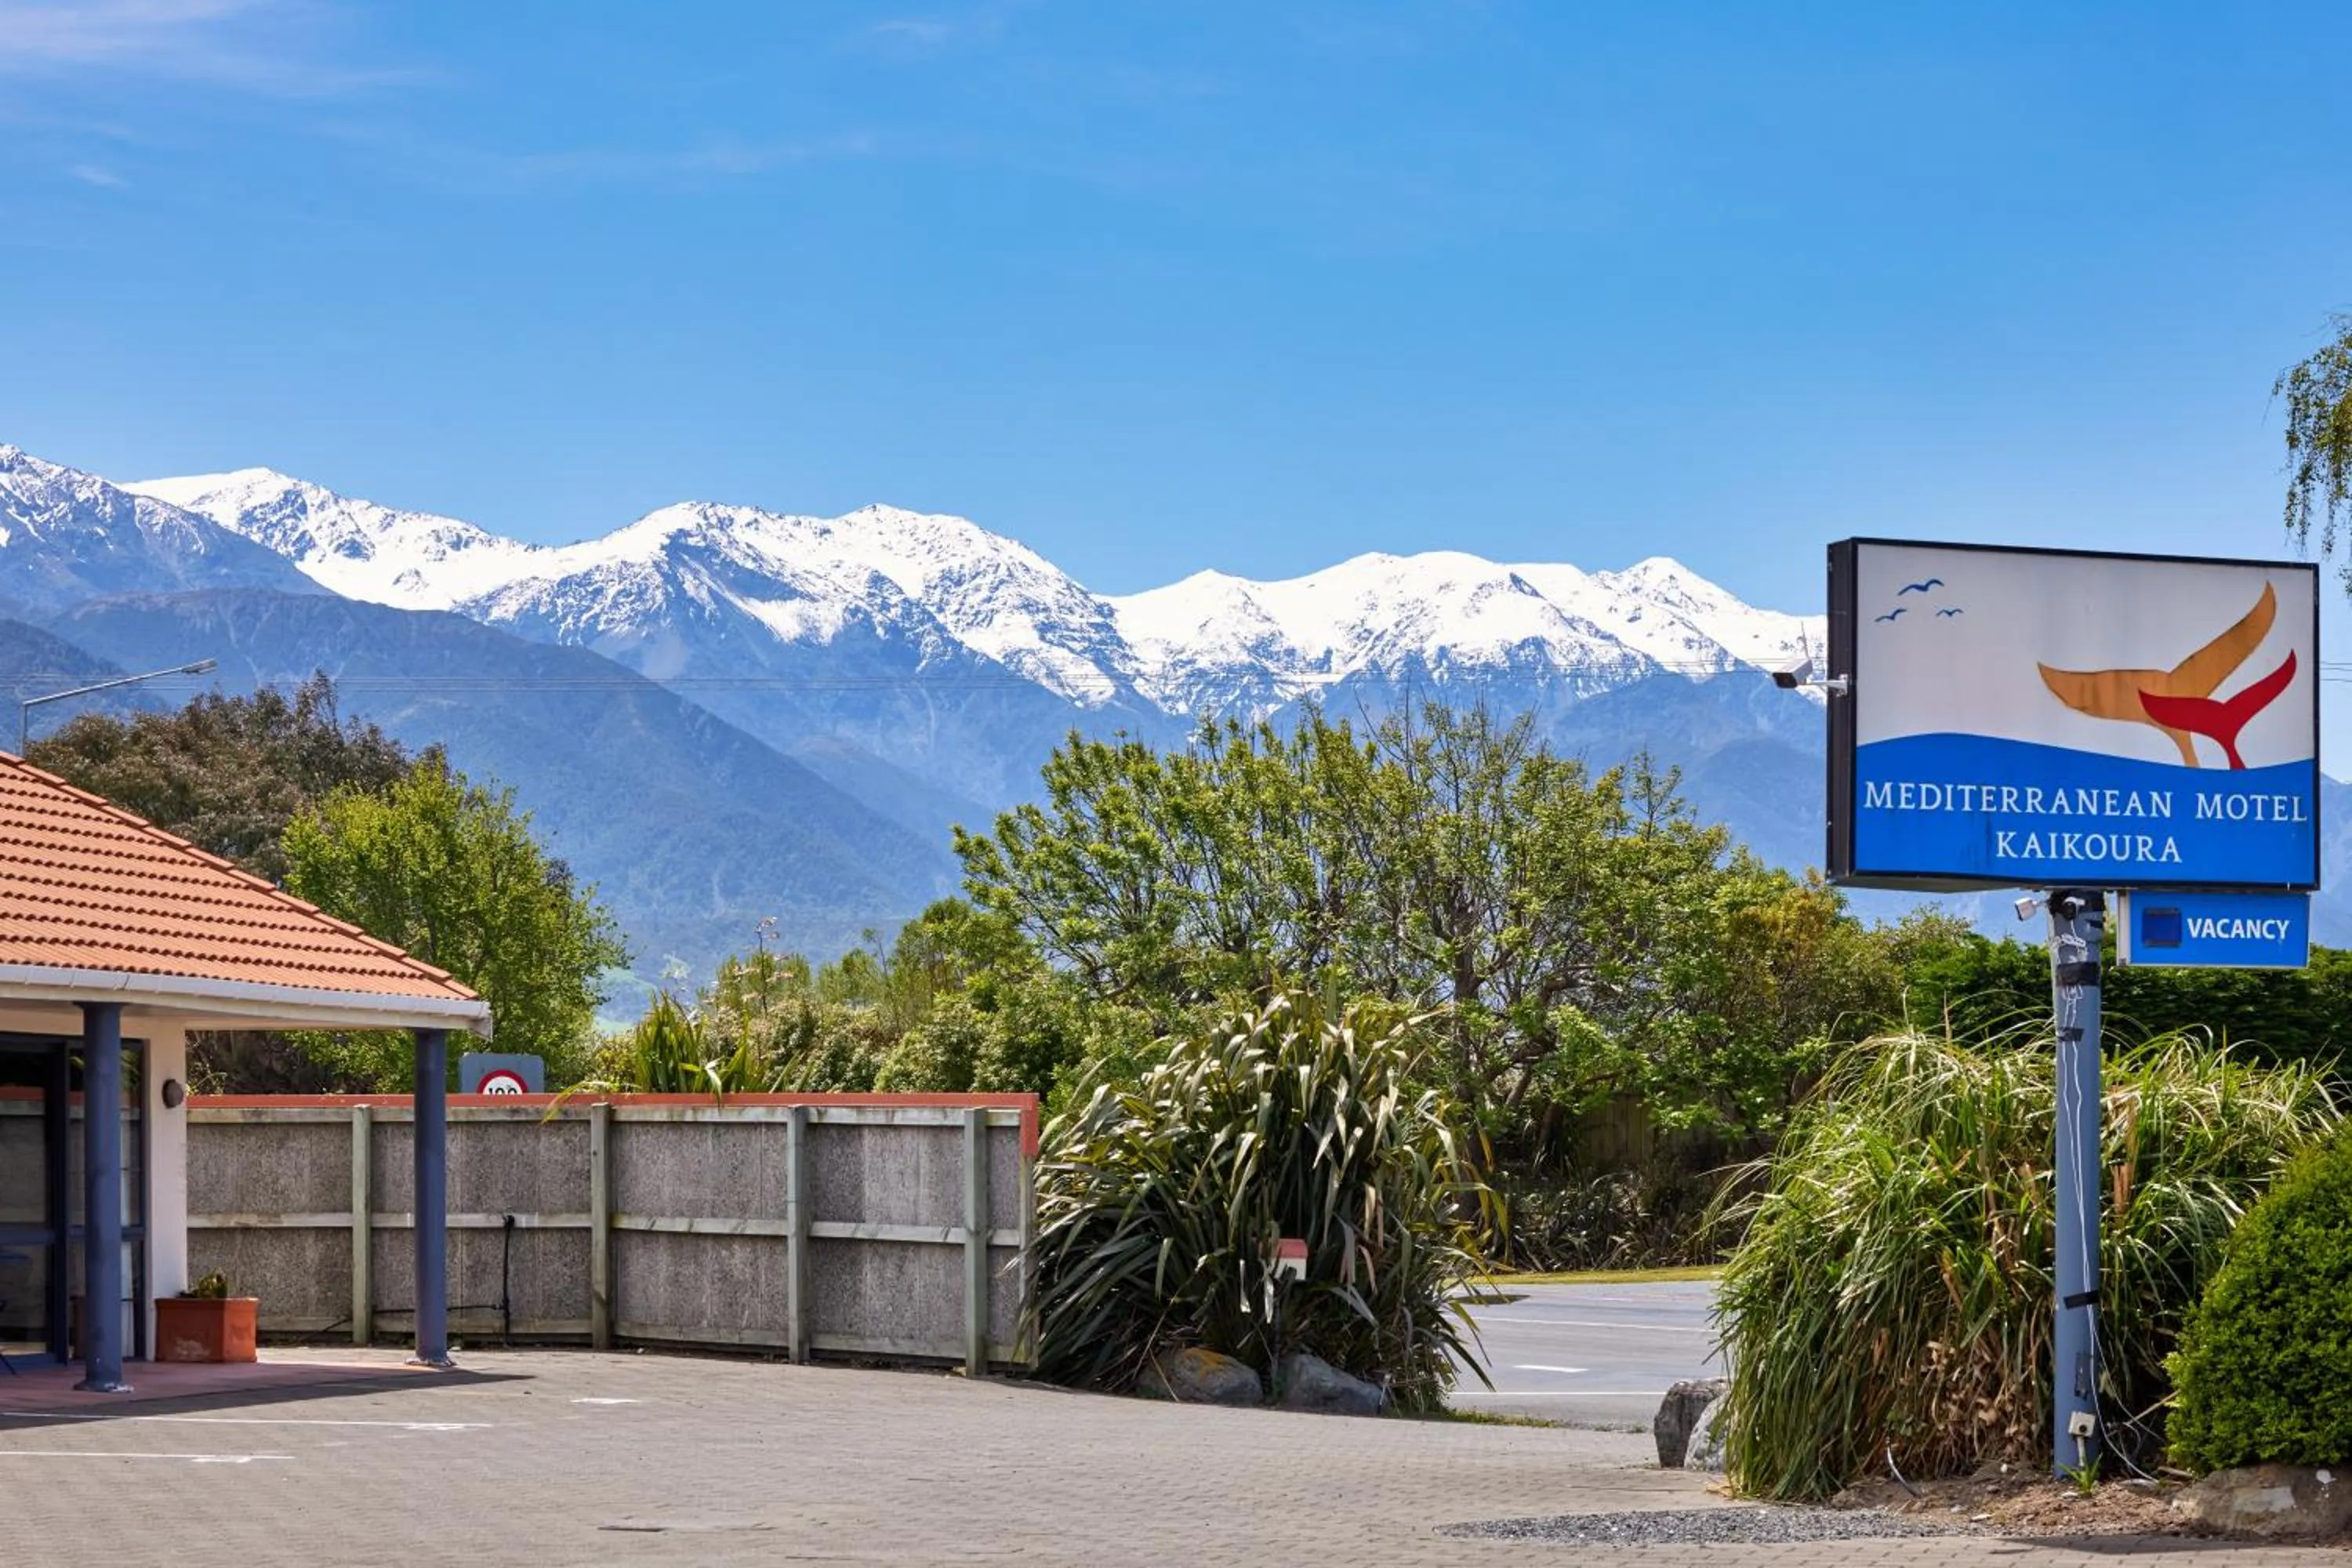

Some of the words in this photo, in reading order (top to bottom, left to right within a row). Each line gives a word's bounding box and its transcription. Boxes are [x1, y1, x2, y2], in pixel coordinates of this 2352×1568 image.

[1864, 781, 2172, 818] MEDITERRANEAN
[2195, 793, 2308, 822] MOTEL
[1996, 831, 2183, 863] KAIKOURA
[2187, 917, 2290, 940] VACANCY
